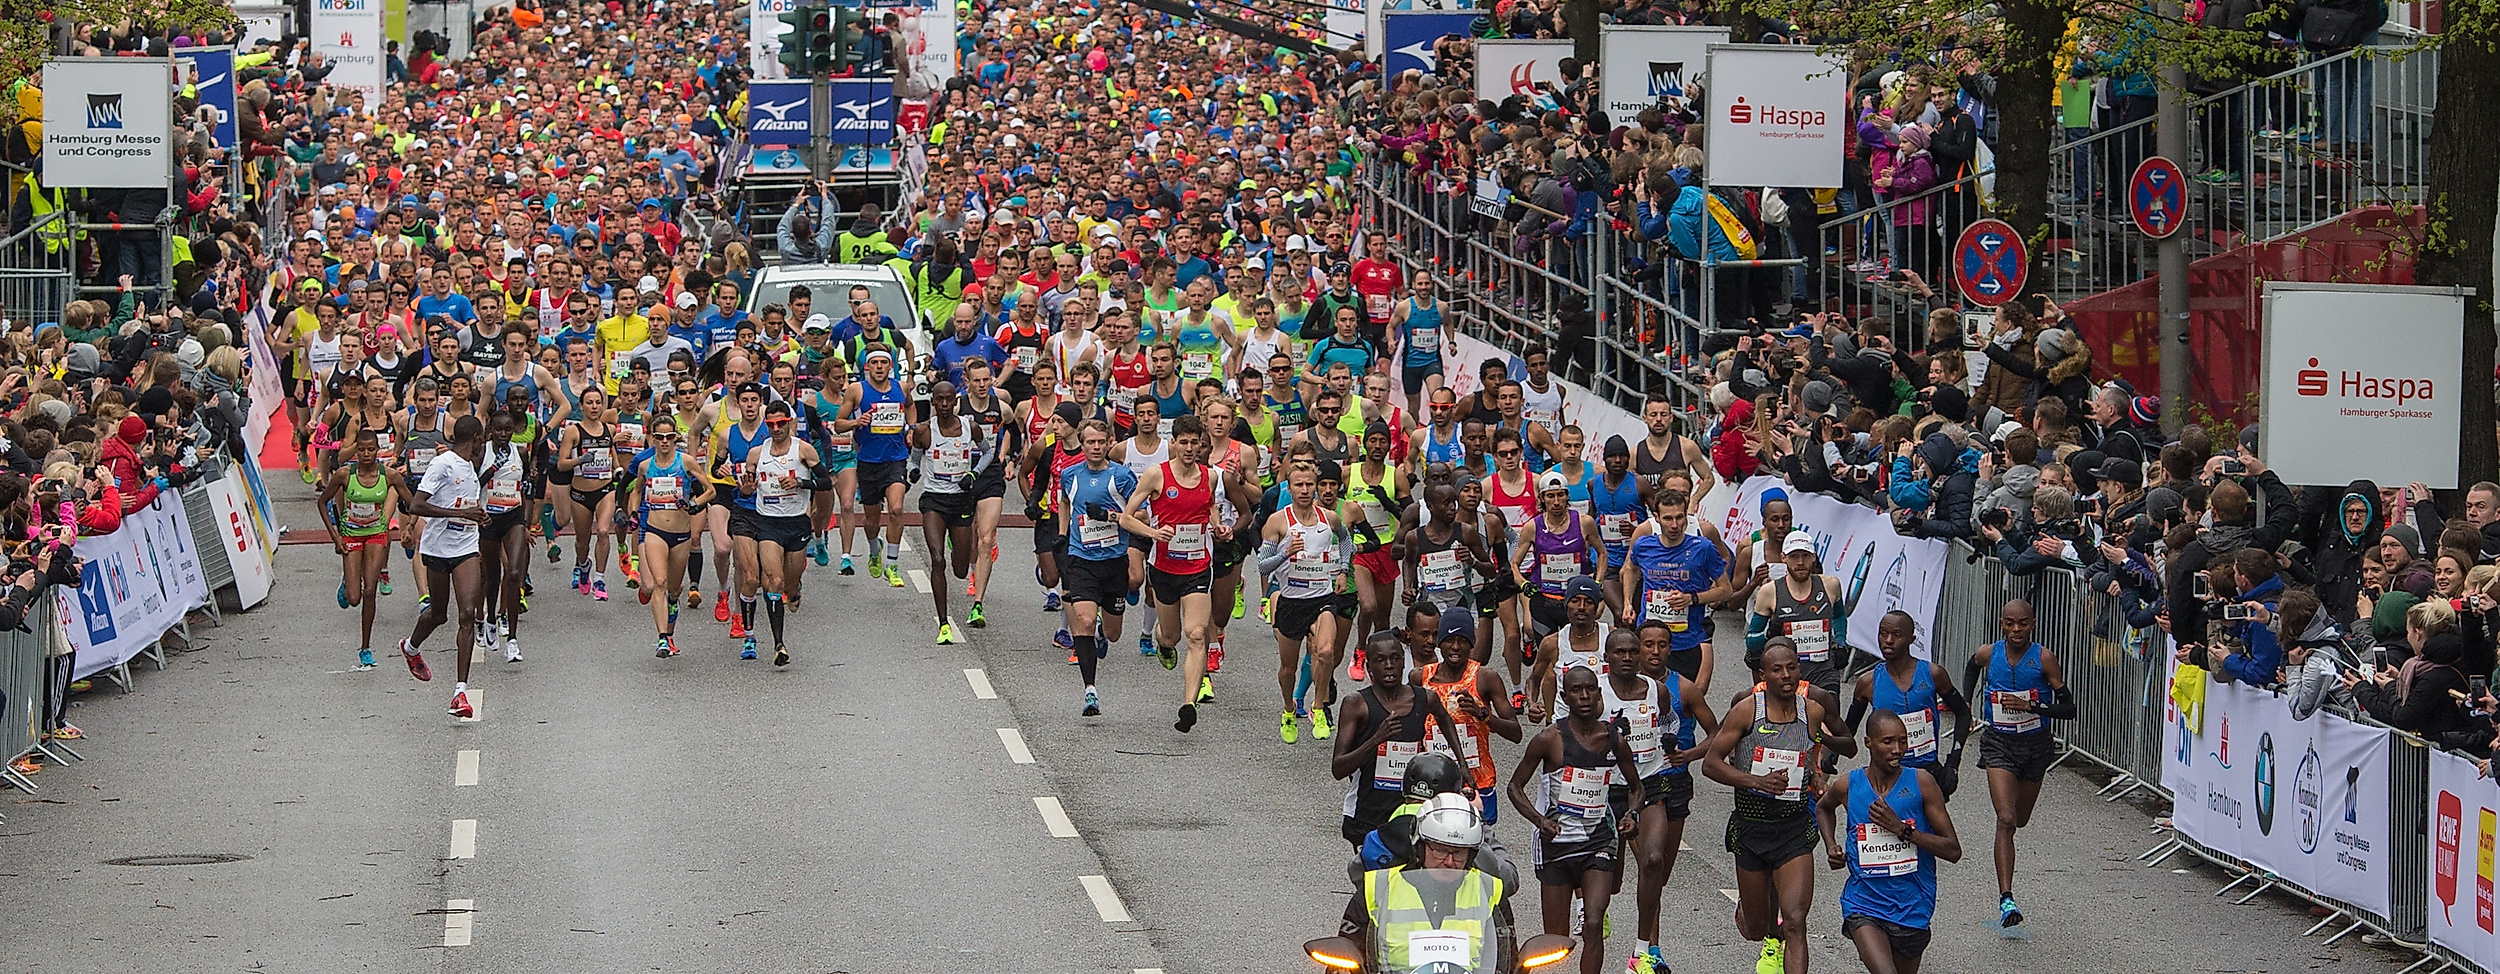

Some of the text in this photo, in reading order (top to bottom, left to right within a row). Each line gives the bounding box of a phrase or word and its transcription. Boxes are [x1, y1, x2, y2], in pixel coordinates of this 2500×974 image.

[1760, 105, 1825, 130] Haspa
[49, 134, 161, 146] Hamburg Messe
[1759, 131, 1825, 140] Hamburger Sparkasse
[58, 146, 152, 158] und Congress
[1472, 197, 1505, 219] MARTIN
[851, 244, 871, 259] 28
[1189, 361, 1206, 369] 1042
[2341, 370, 2433, 406] Haspa
[873, 412, 898, 421] 20457
[1279, 413, 1302, 425] RASIL
[2340, 407, 2433, 419] Hamburger Sparkasse
[1084, 524, 1112, 534] Uhrbom
[1294, 564, 1323, 572] Ionescu
[1546, 566, 1574, 574] Barzola
[1793, 634, 1827, 645] chöfisch
[1907, 726, 1926, 739] sgei
[1776, 752, 1795, 762] Haspa
[1388, 759, 1407, 769] Lim
[1570, 785, 1602, 799] Langat
[2207, 781, 2242, 830] Hamburg
[2439, 813, 2458, 847] REWE
[1861, 842, 1911, 853] Kendagor
[2353, 833, 2370, 853] Messe
[2345, 850, 2367, 872] Congress
[1423, 944, 1450, 952] MOTO
